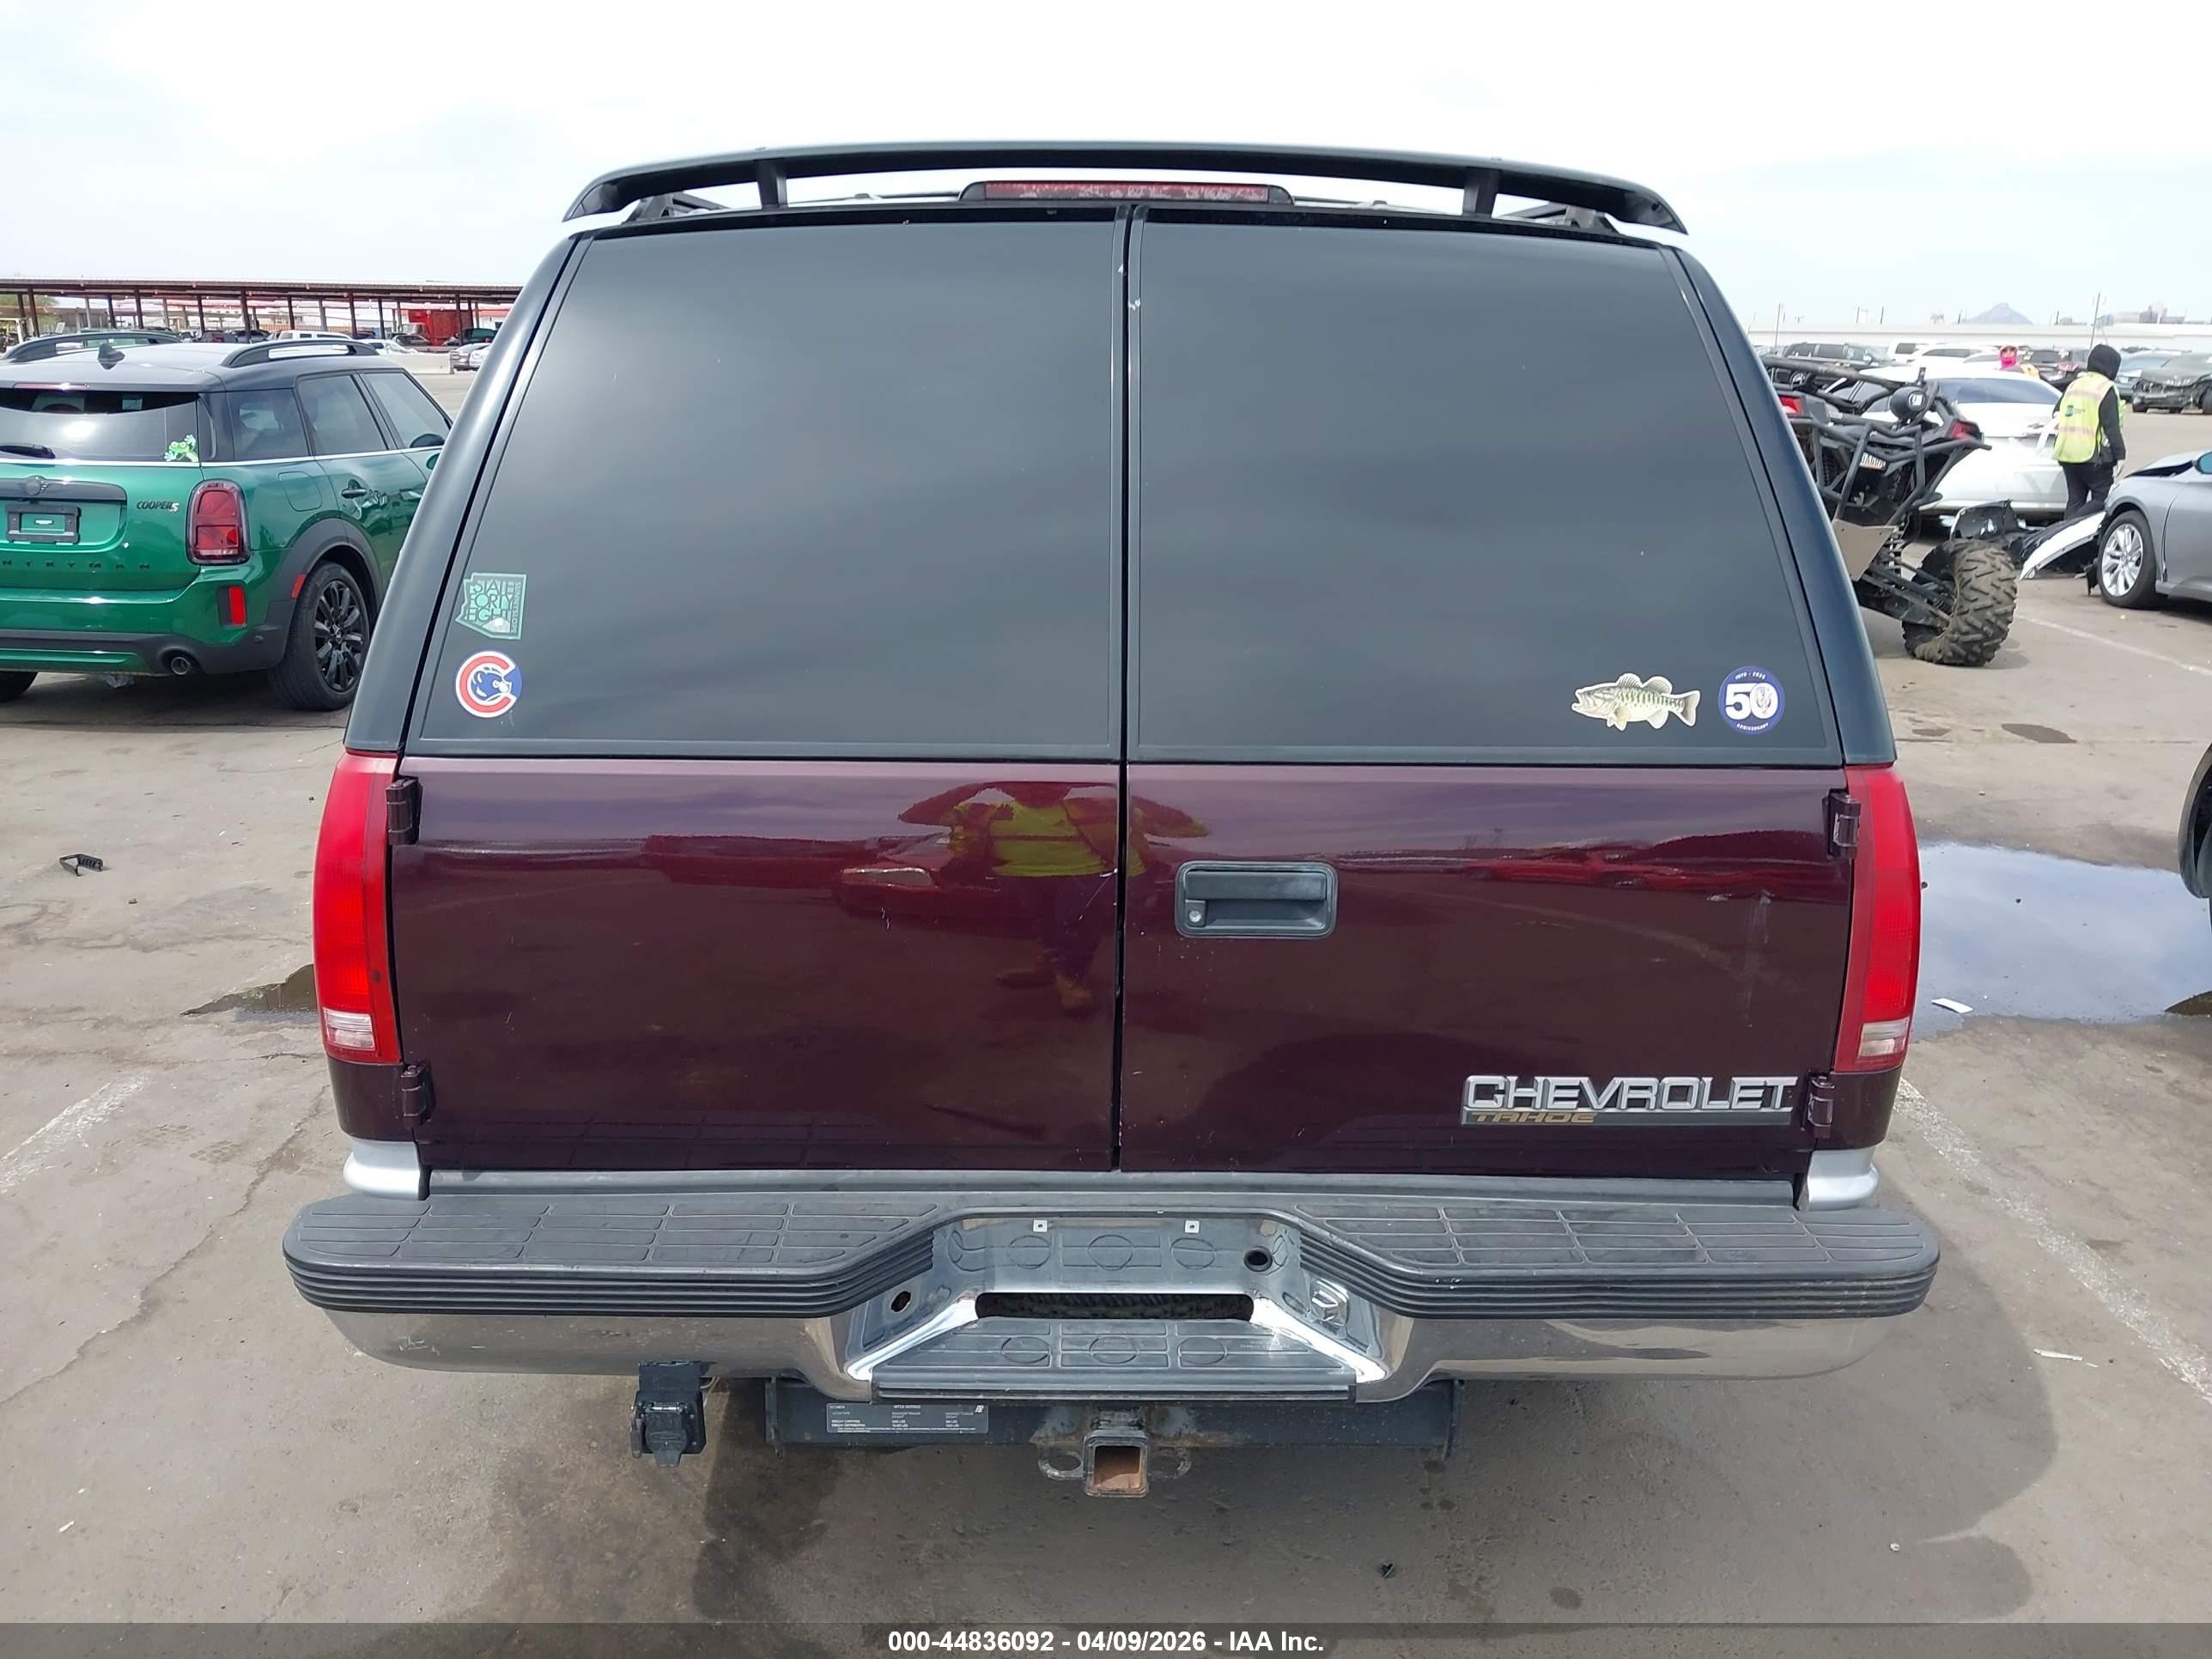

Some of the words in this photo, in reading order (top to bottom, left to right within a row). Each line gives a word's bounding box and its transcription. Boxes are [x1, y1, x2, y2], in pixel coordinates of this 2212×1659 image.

[1725, 682, 1778, 720] 50
[1464, 1075, 1798, 1109] CHEVROLET
[1471, 1112, 1597, 1123] TAHOE
